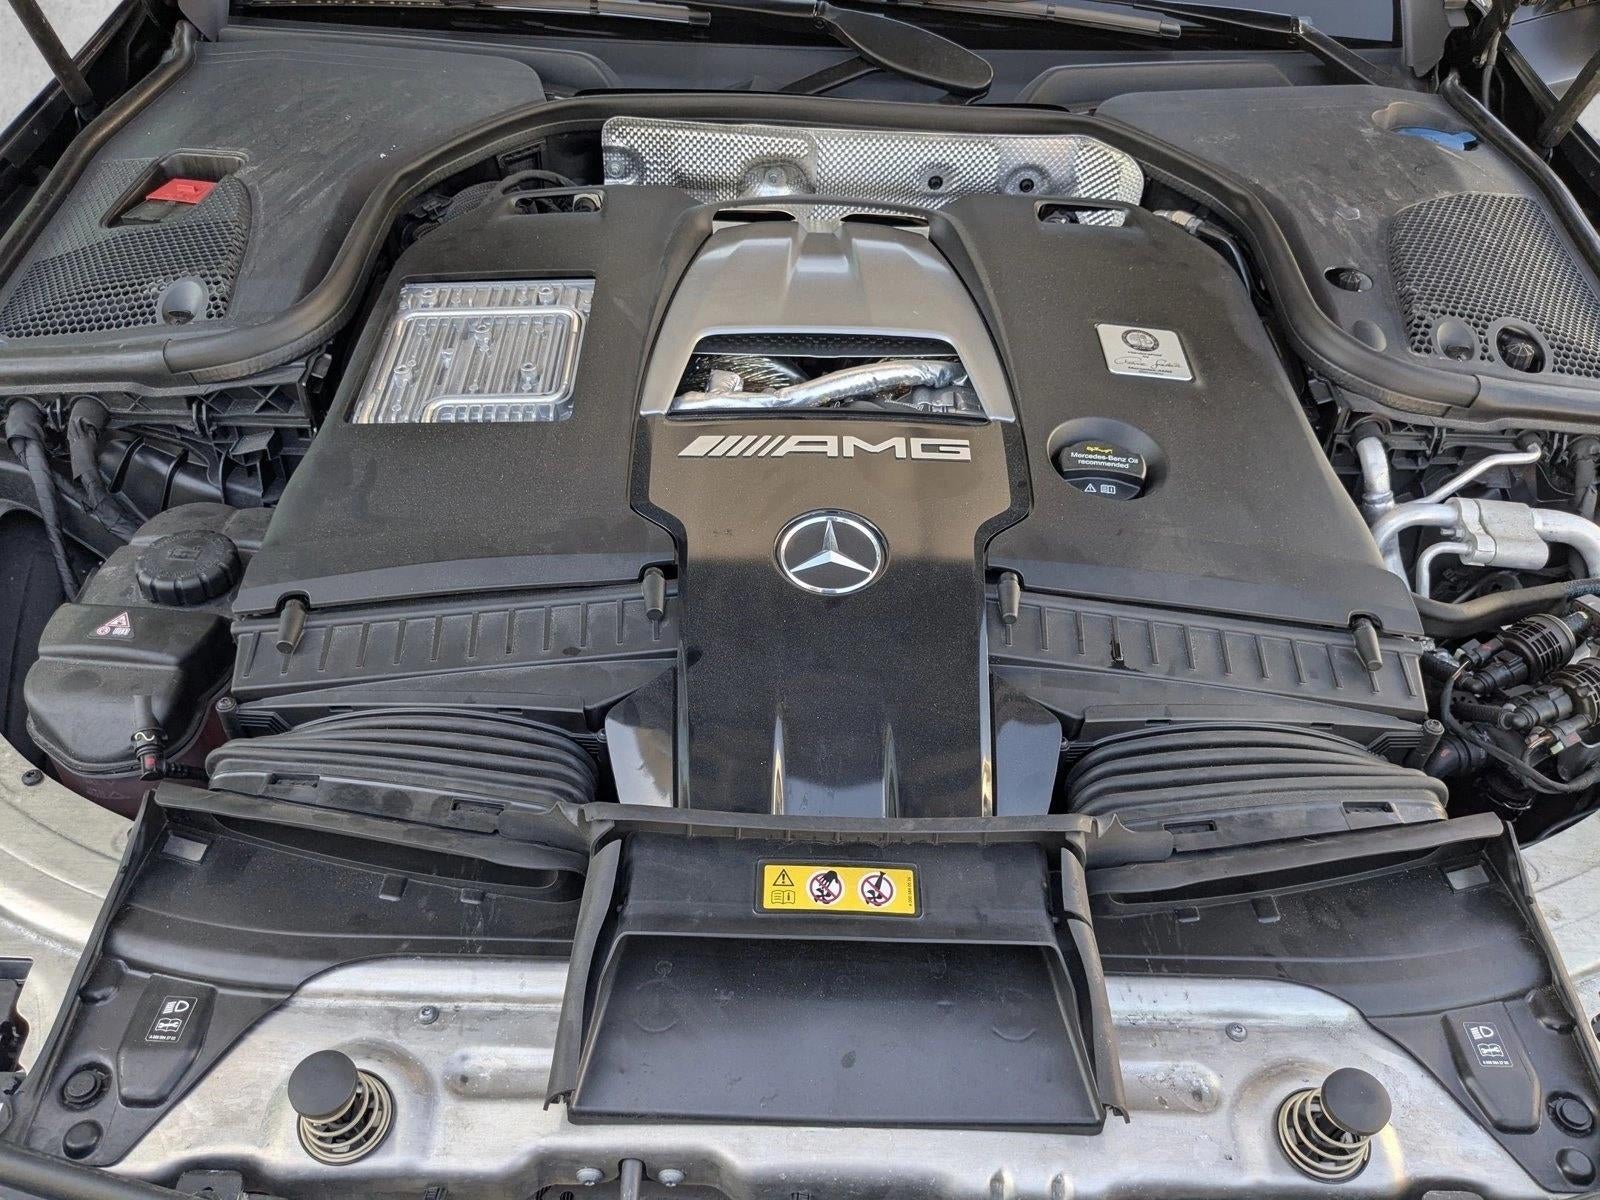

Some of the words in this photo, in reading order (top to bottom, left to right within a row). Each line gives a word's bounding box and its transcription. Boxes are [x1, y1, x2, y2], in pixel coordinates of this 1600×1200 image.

[770, 435, 972, 462] AMG
[1070, 451, 1127, 463] Mercedes-Benz
[1127, 456, 1139, 464] Oil
[1078, 459, 1130, 469] recommended
